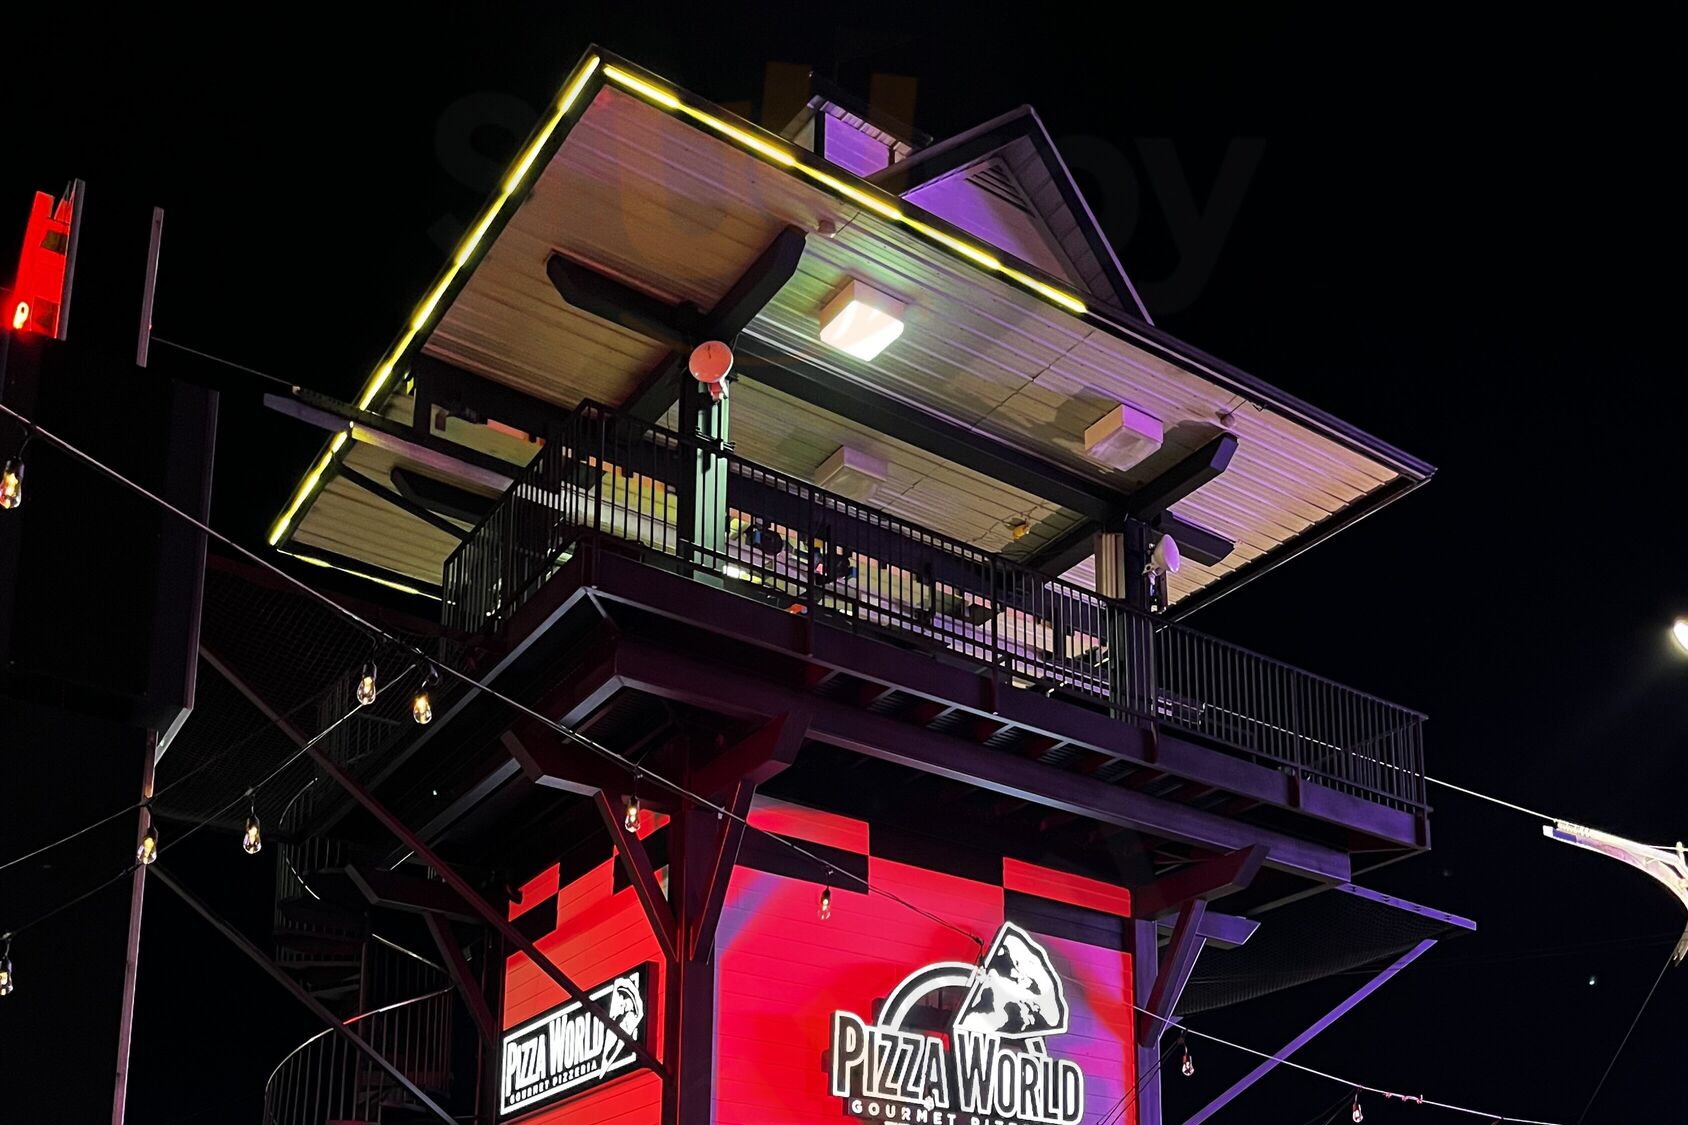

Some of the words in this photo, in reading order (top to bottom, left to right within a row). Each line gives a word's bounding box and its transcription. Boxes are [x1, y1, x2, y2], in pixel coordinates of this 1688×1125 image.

[505, 1033, 547, 1098] PIZZA
[549, 1011, 605, 1076] WORLD
[831, 1010, 950, 1109] PIZZA
[953, 1026, 1085, 1125] WORLD
